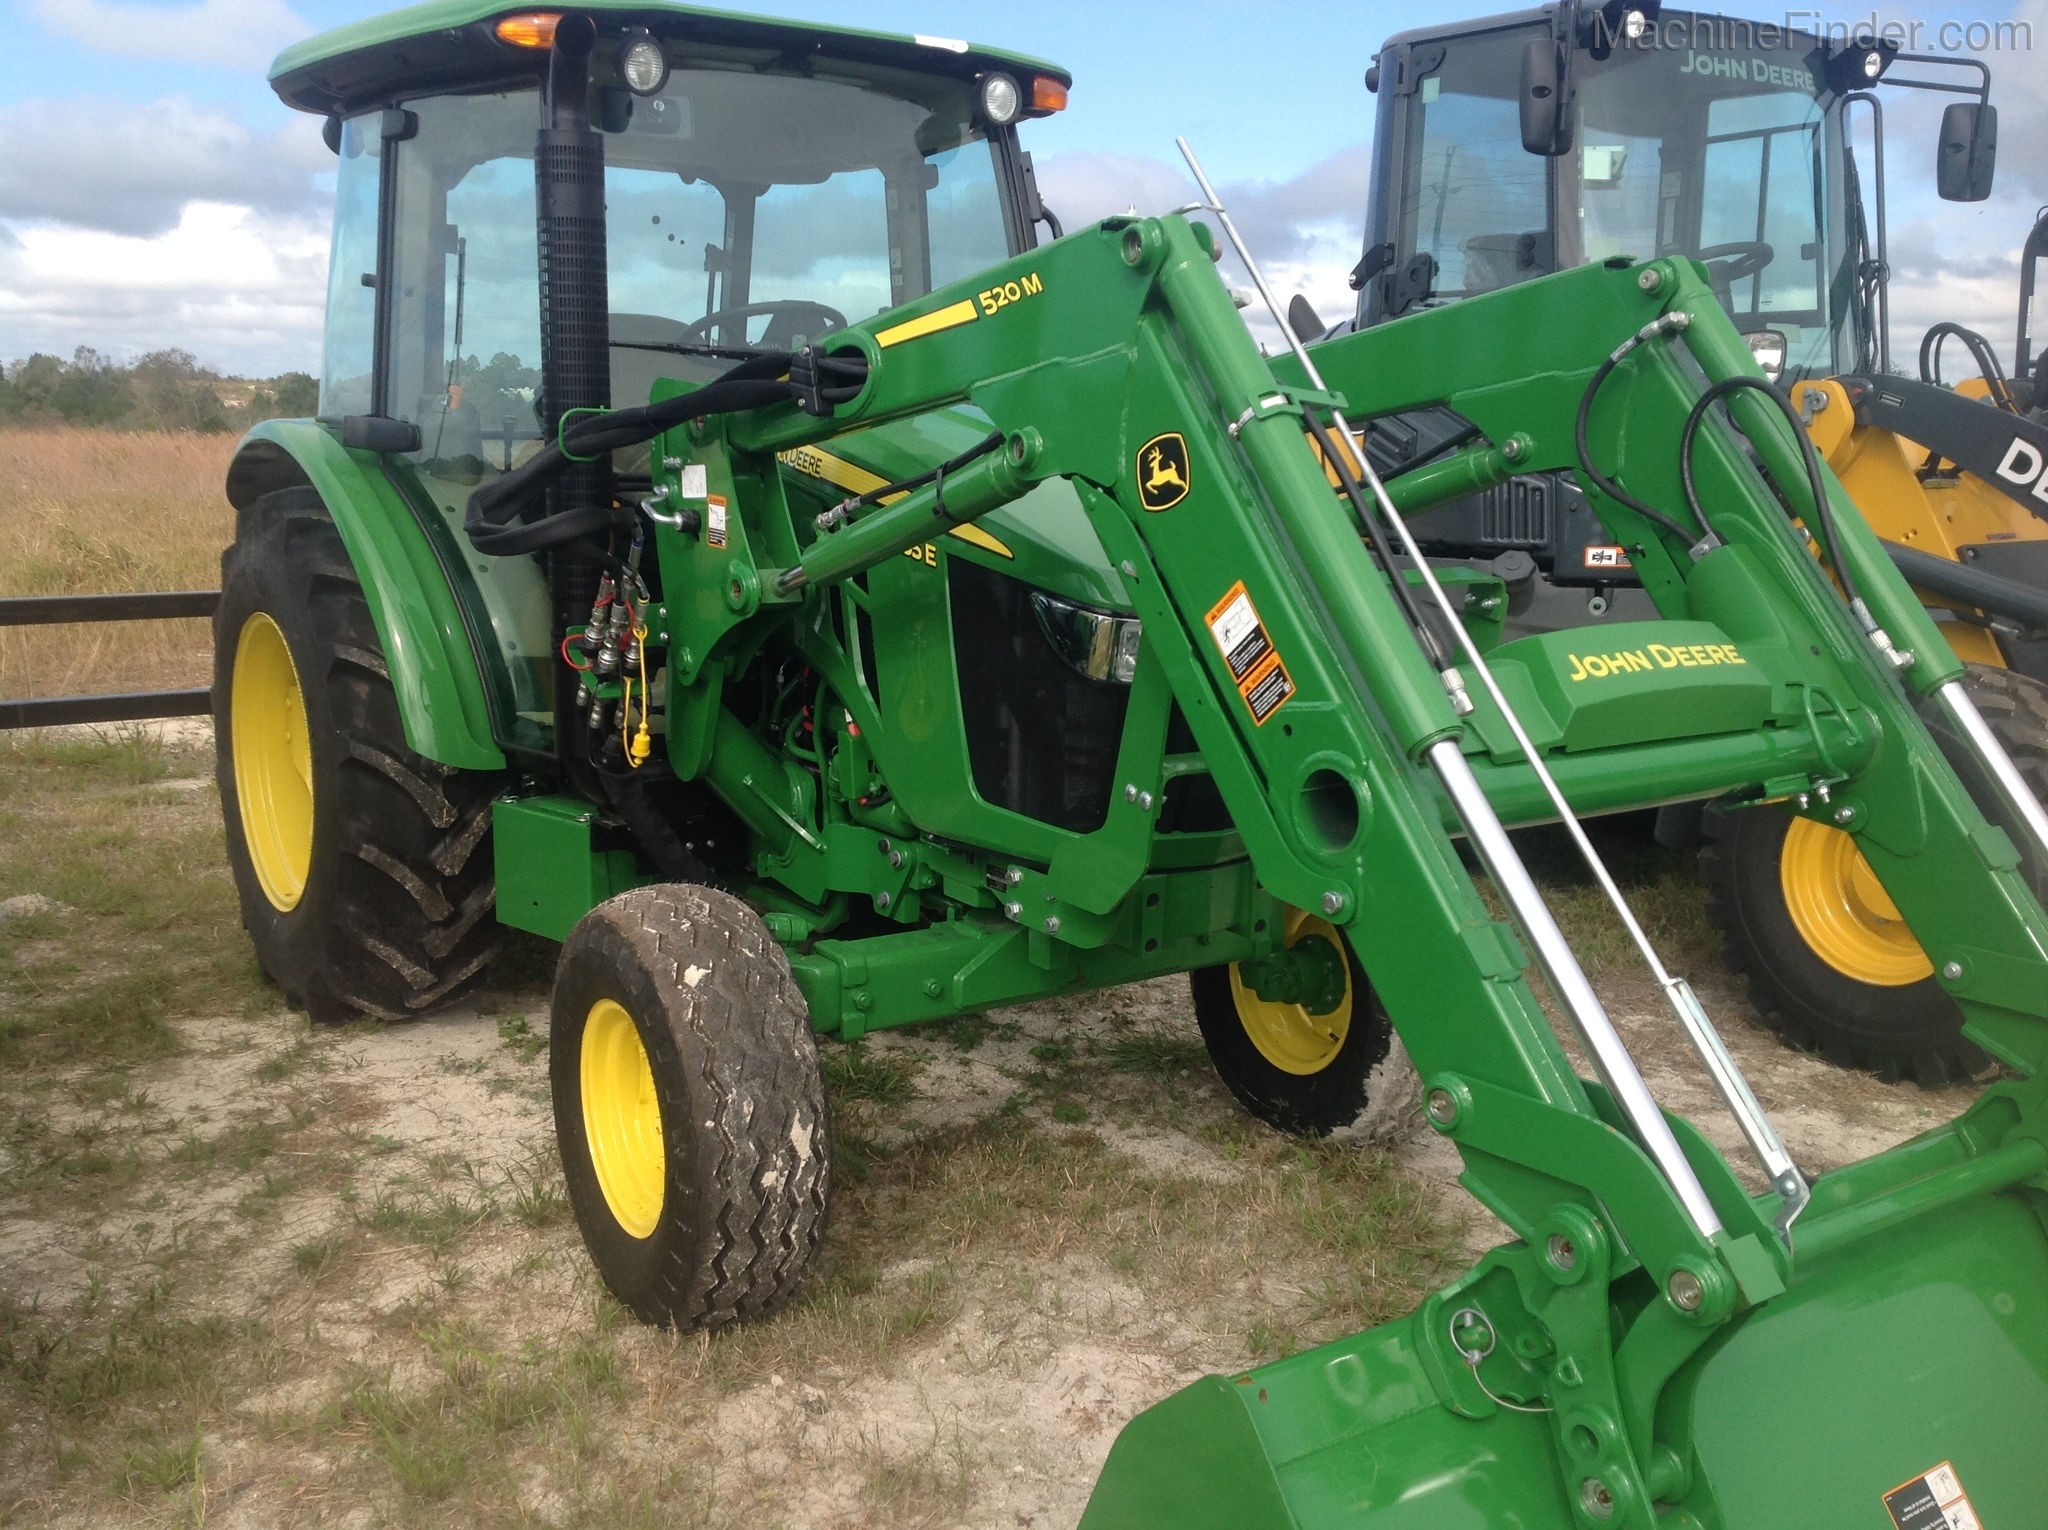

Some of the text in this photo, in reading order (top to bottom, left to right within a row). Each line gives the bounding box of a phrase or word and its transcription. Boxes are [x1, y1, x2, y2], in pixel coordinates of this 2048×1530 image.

[1680, 49, 1815, 92] JOHN DEERE
[978, 272, 1043, 316] 520 M
[789, 448, 823, 476] DEERE
[1216, 588, 1240, 614] WARNING
[1251, 658, 1277, 686] WARNING
[1568, 643, 1747, 682] JOHN DEERE
